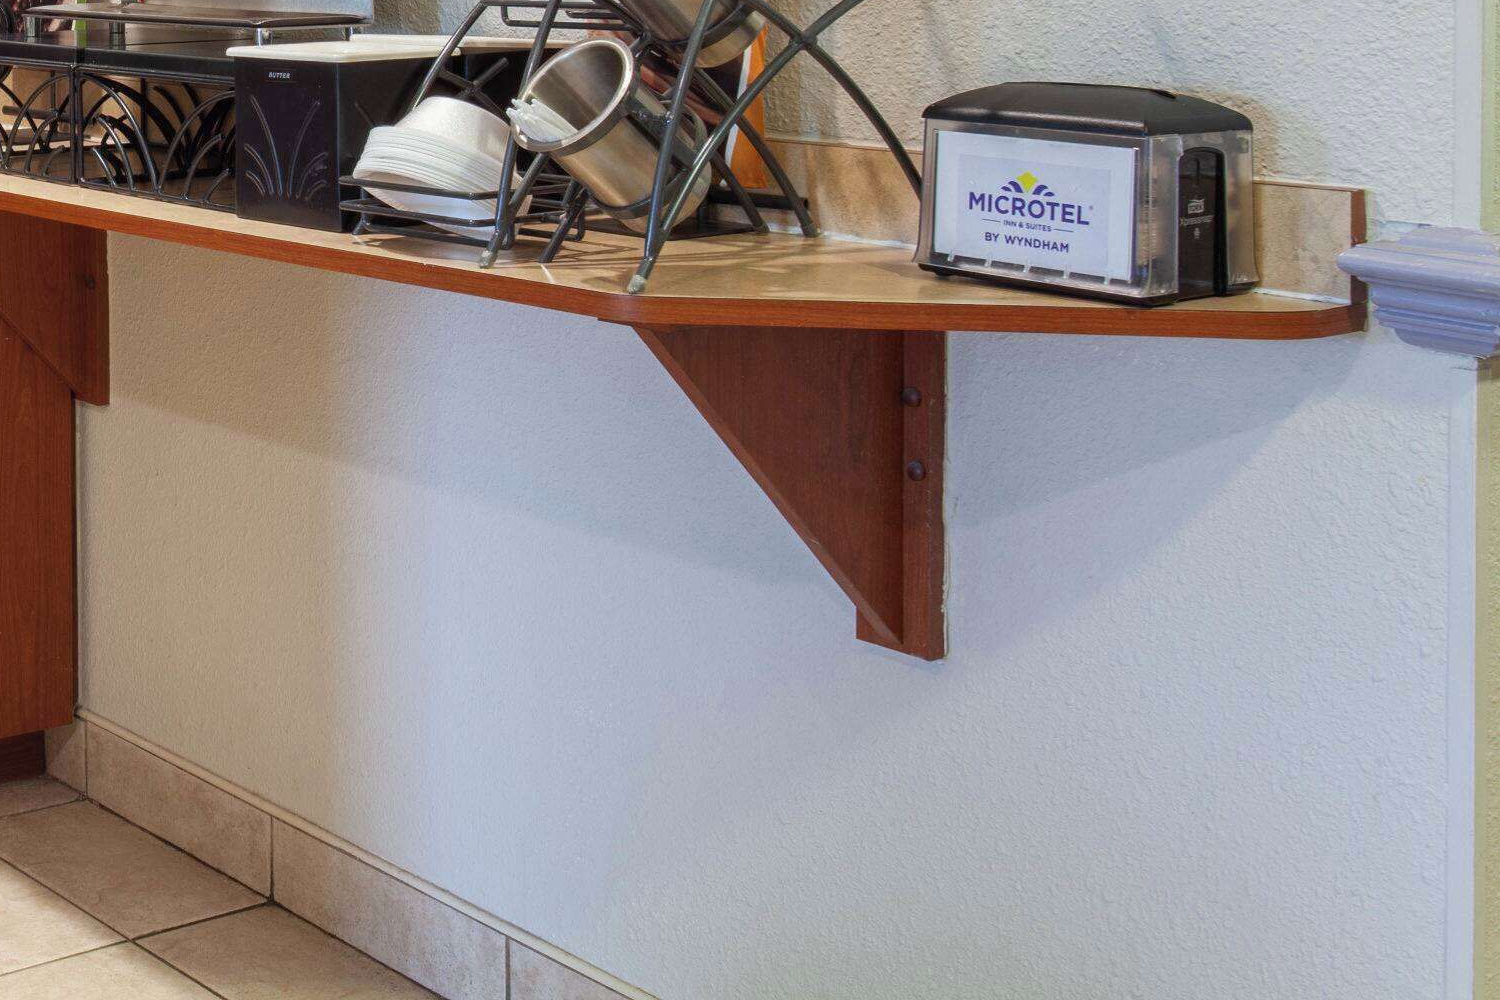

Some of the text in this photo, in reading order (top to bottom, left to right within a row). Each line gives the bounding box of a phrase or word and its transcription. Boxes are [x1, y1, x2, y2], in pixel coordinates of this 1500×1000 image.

[268, 71, 291, 79] BUTTER
[968, 191, 1090, 225] MICROTEL
[1025, 223, 1052, 232] SUITES
[984, 232, 1069, 253] BY WYNDHAM
